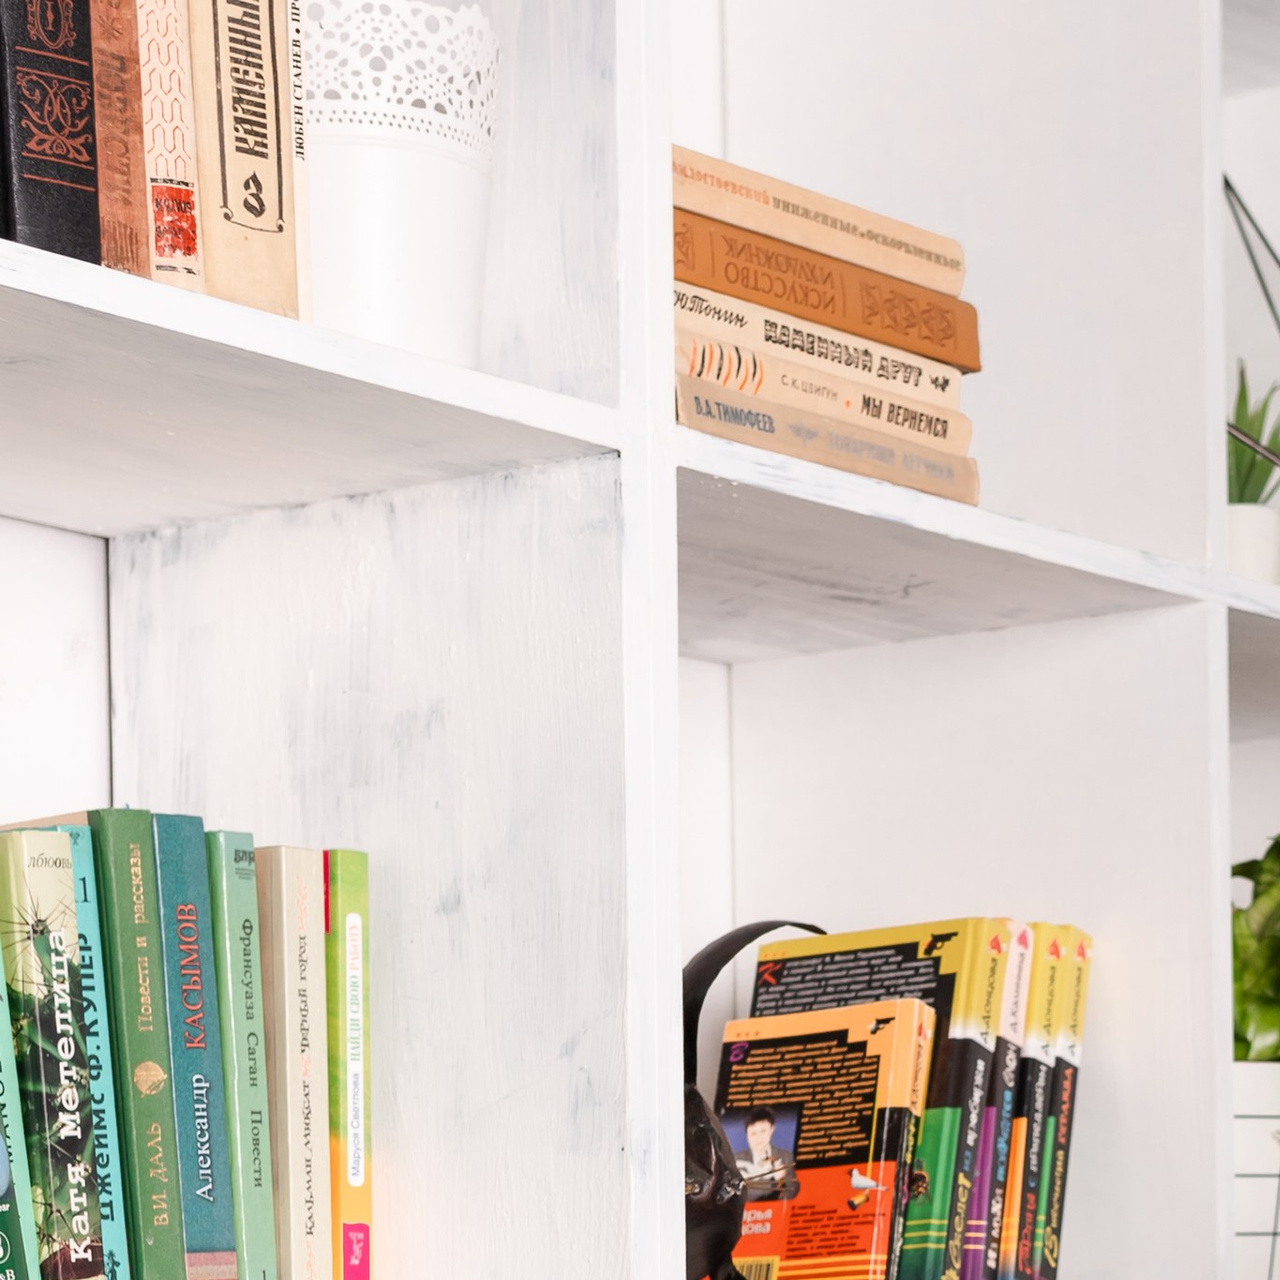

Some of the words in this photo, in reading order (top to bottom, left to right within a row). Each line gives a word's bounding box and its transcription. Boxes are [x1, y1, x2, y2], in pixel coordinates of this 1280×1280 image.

[291, 38, 304, 101] СТАНЕВ
[293, 105, 306, 160] ЛЮБЕН
[860, 393, 882, 420] МЫ
[886, 404, 949, 440] ВЕРНЕМСЯ
[130, 842, 150, 925] рассказы
[138, 953, 154, 1034] Повести
[175, 902, 207, 1050] КАСЫМОВ
[240, 917, 255, 1021] Франсуаза
[48, 927, 83, 1142] Метелица
[246, 1032, 259, 1088] Саган
[186, 1074, 215, 1203] Александр
[350, 1072, 361, 1133] Светлова
[145, 1121, 167, 1191] ДАЛЬ
[249, 1108, 265, 1188] Повести
[350, 1132, 362, 1178] Маруся
[66, 1160, 93, 1264] Катя
